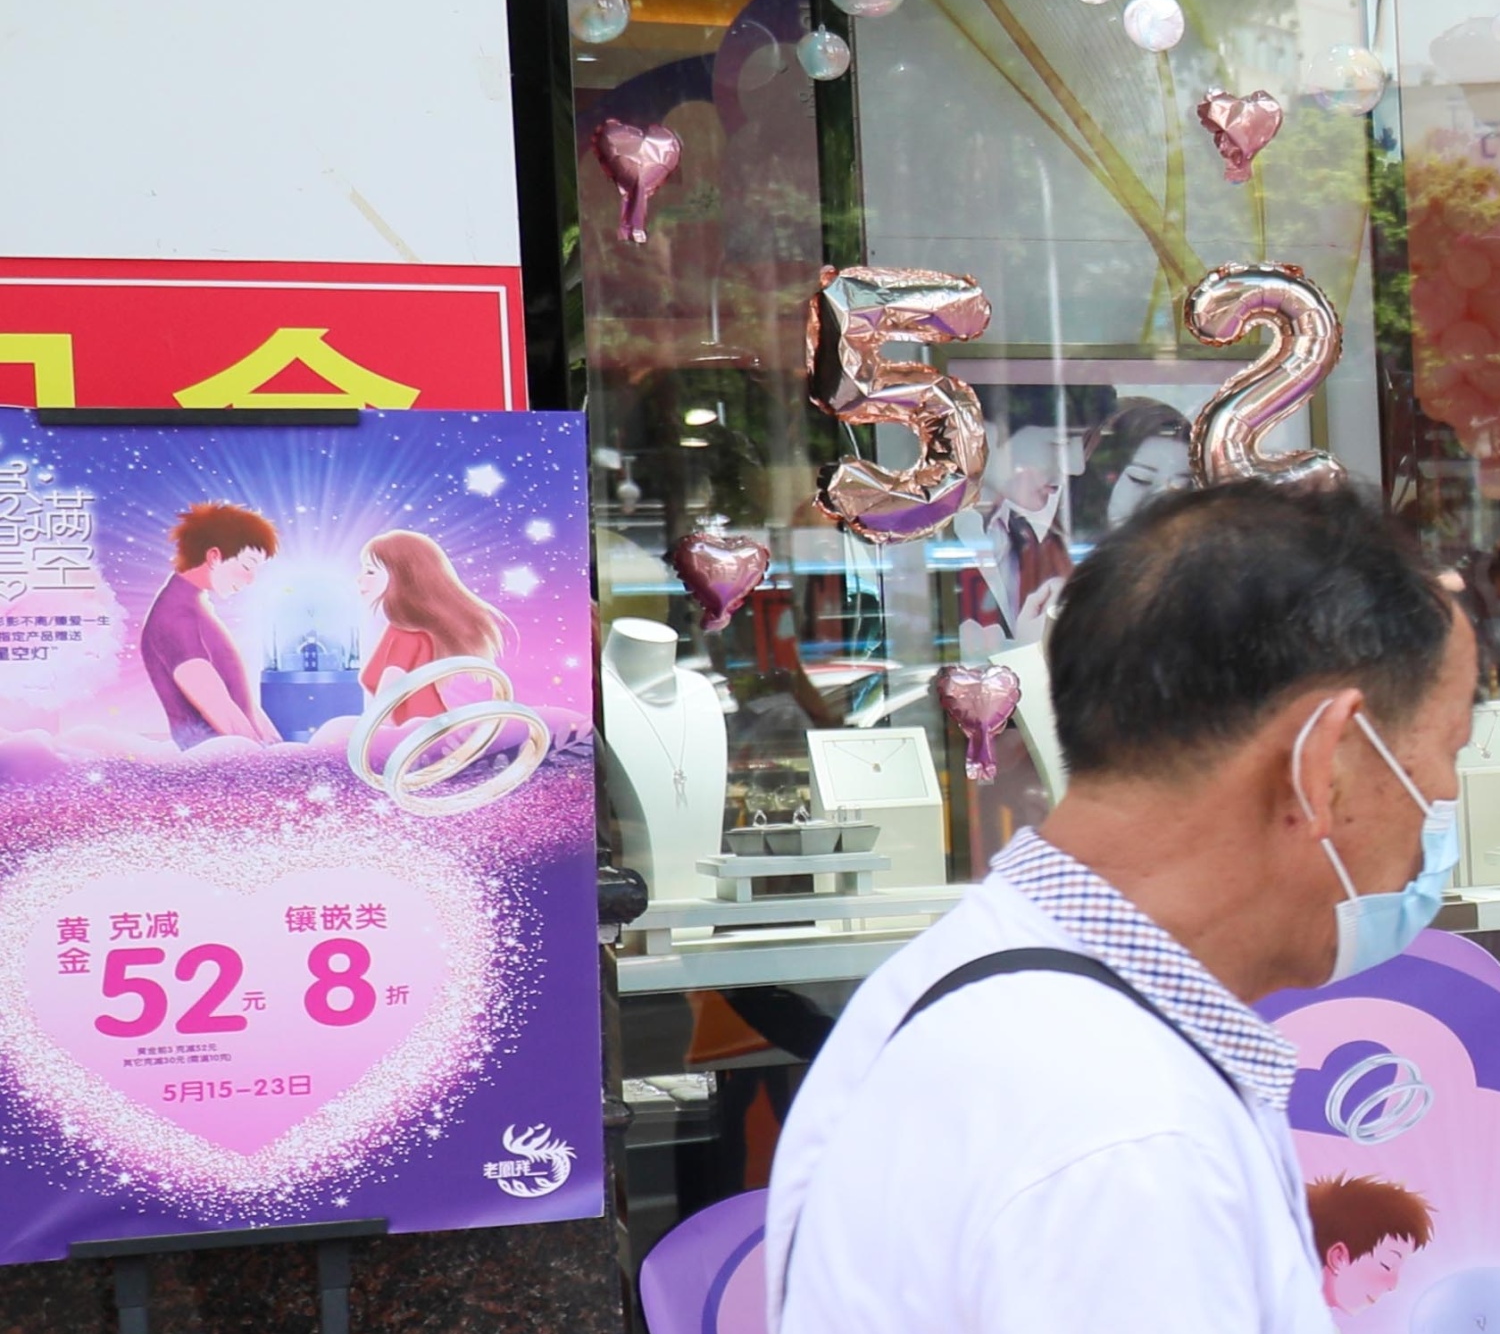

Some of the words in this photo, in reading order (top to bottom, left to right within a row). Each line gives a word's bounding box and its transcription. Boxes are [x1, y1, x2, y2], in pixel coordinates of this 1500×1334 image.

[109, 911, 180, 941] 克减
[285, 904, 388, 933] 镶嵌类
[57, 917, 91, 975] 黄金
